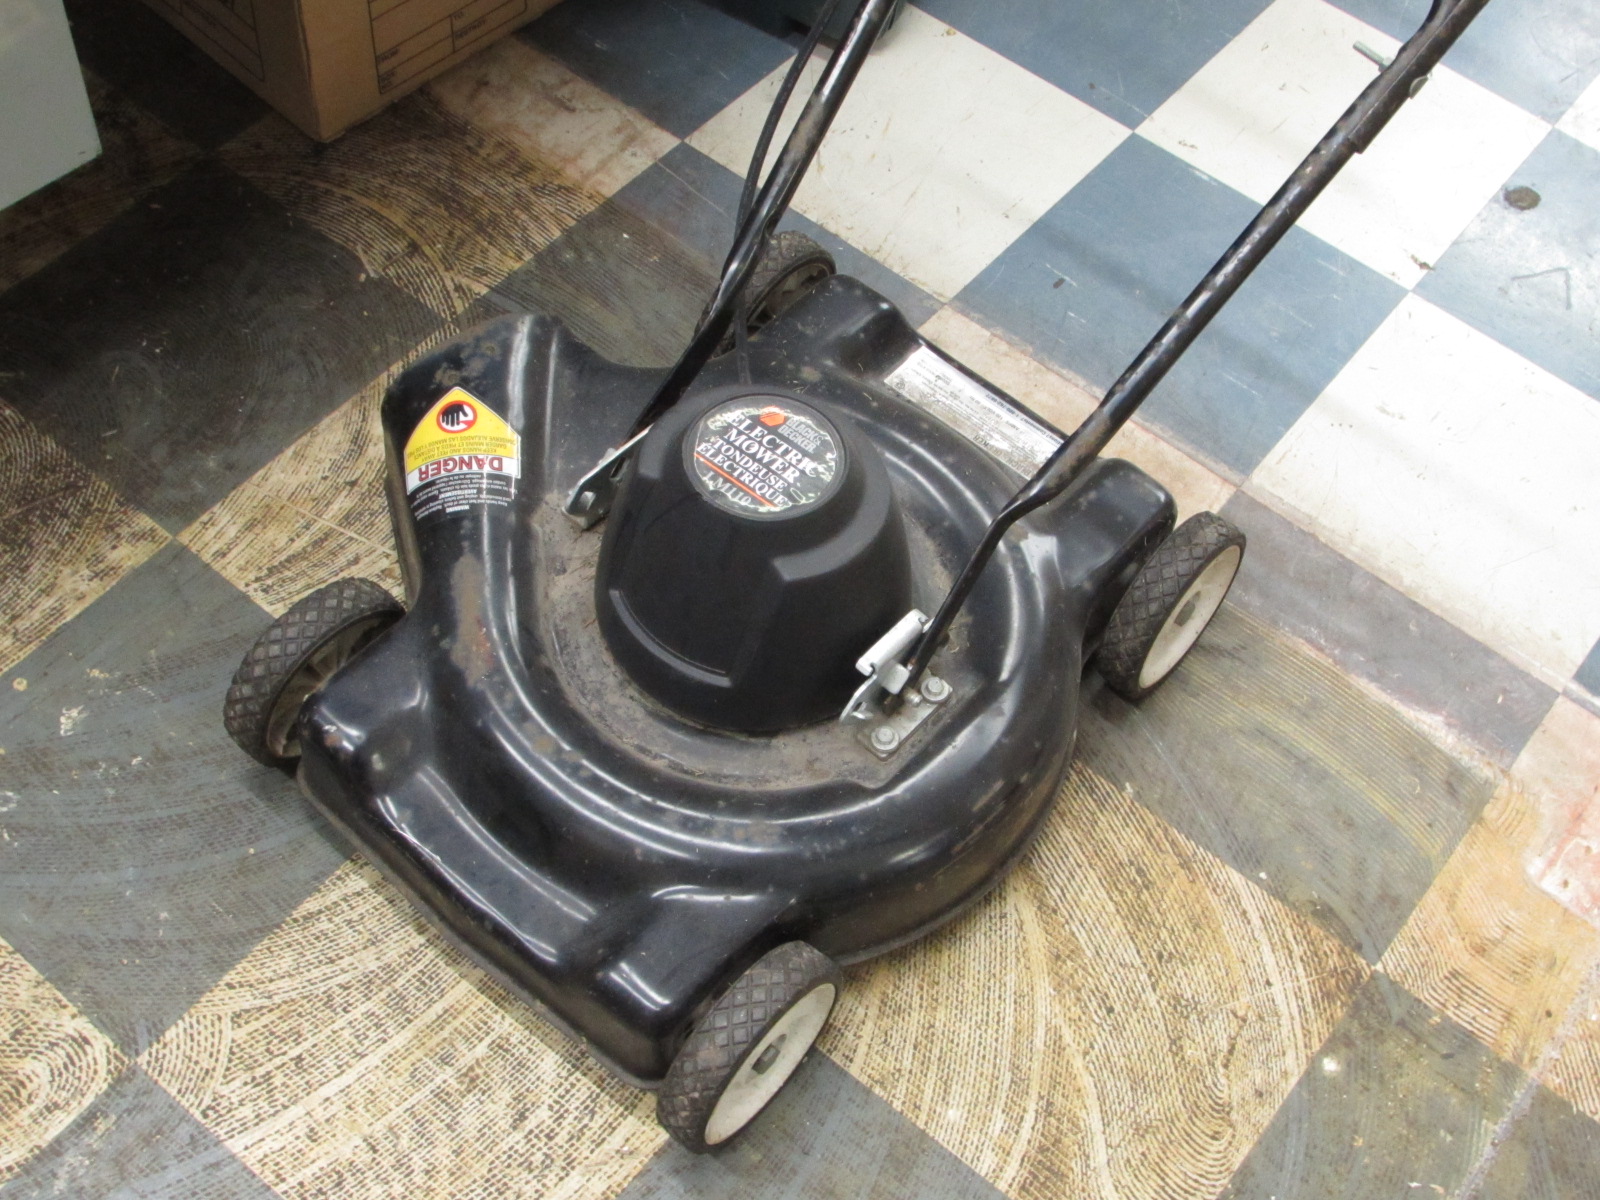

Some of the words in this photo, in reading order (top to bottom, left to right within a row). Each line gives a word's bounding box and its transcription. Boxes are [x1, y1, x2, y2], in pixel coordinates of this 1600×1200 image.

[723, 428, 801, 484] MOWER
[727, 410, 817, 477] ELECTRIC
[777, 425, 817, 454] DECKER
[418, 455, 503, 482] DANGER
[712, 438, 788, 493] TONDEUSE
[446, 504, 470, 513] WARNING
